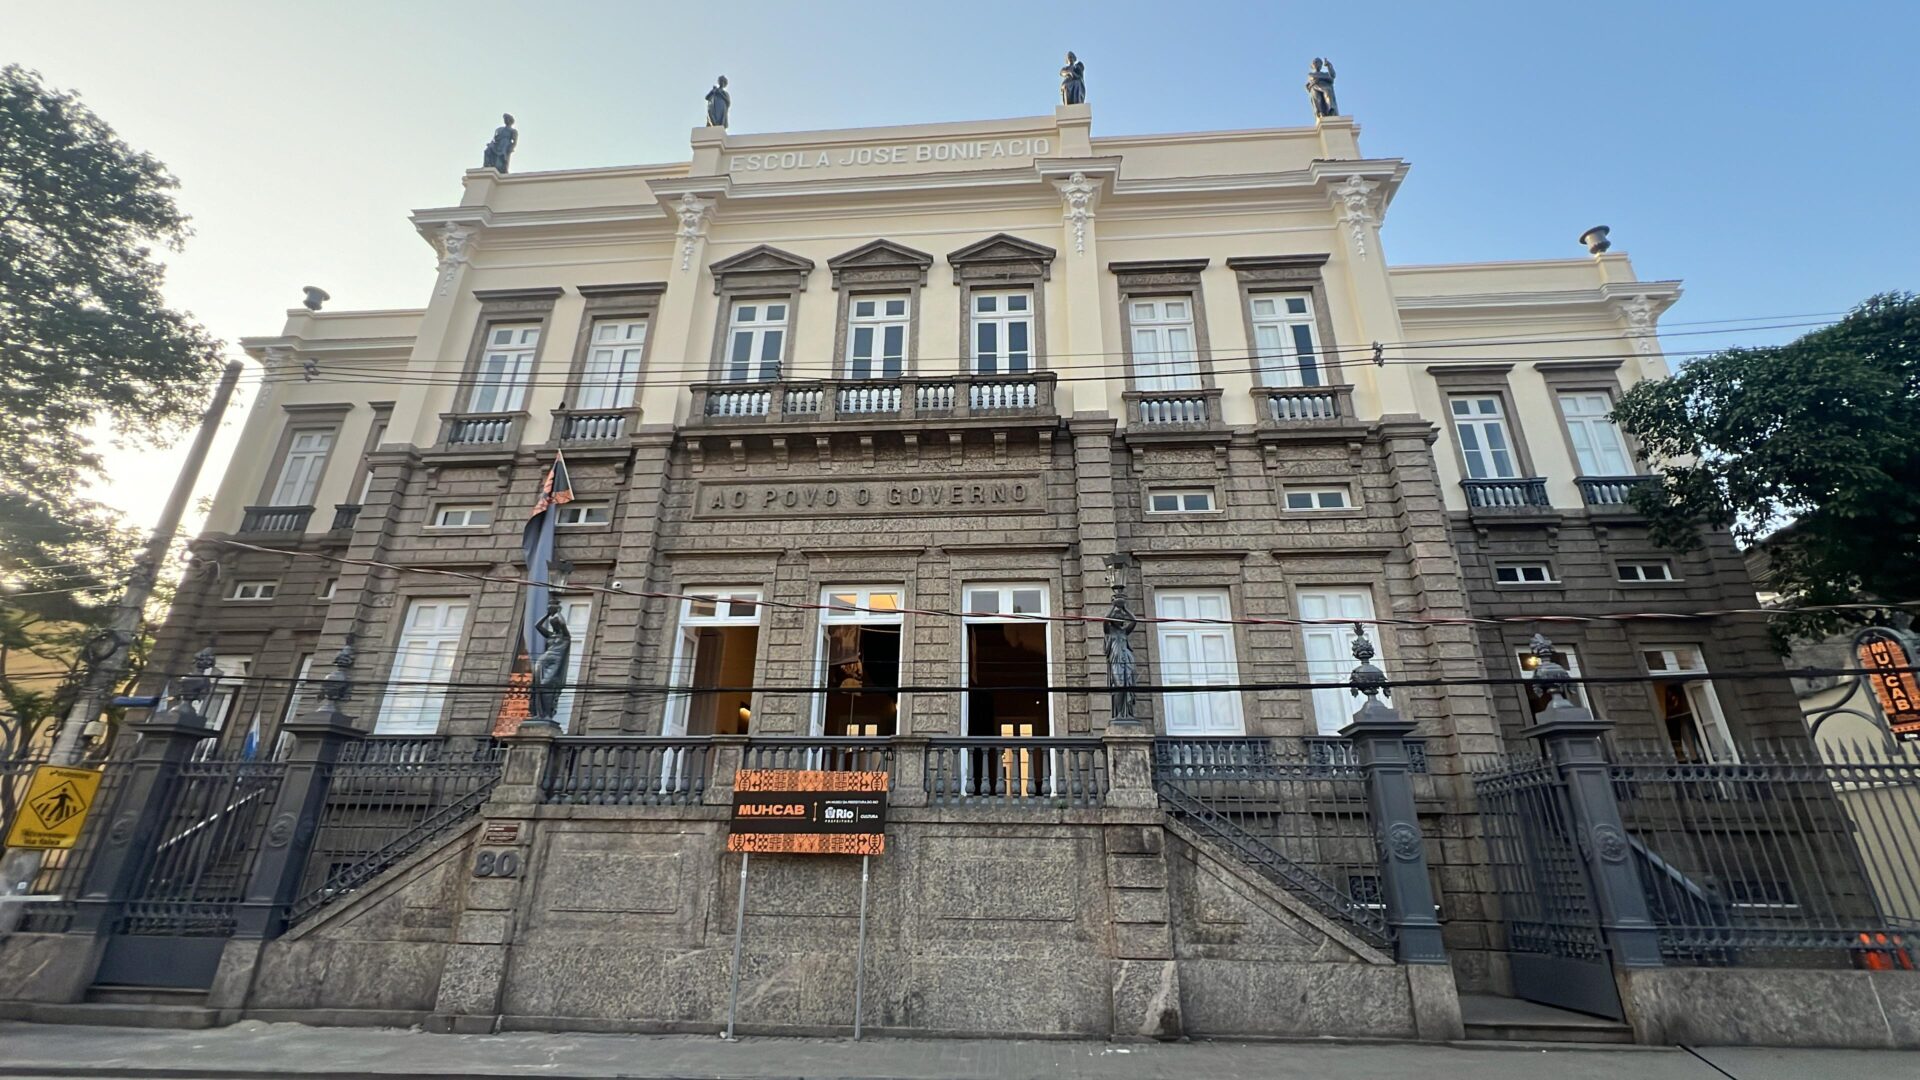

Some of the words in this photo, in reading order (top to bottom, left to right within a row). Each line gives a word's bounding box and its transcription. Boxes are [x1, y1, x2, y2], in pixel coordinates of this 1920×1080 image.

[729, 151, 830, 172] ESCOLA
[839, 145, 908, 166] JOSE
[916, 137, 1050, 162] BONIFACIO
[711, 490, 747, 509] AO
[761, 488, 838, 508] POVO
[855, 488, 871, 506] O
[888, 484, 1028, 505] GOVERNO
[738, 804, 805, 815] MUHCAB
[836, 808, 854, 819] Rio
[472, 850, 518, 877] 80
